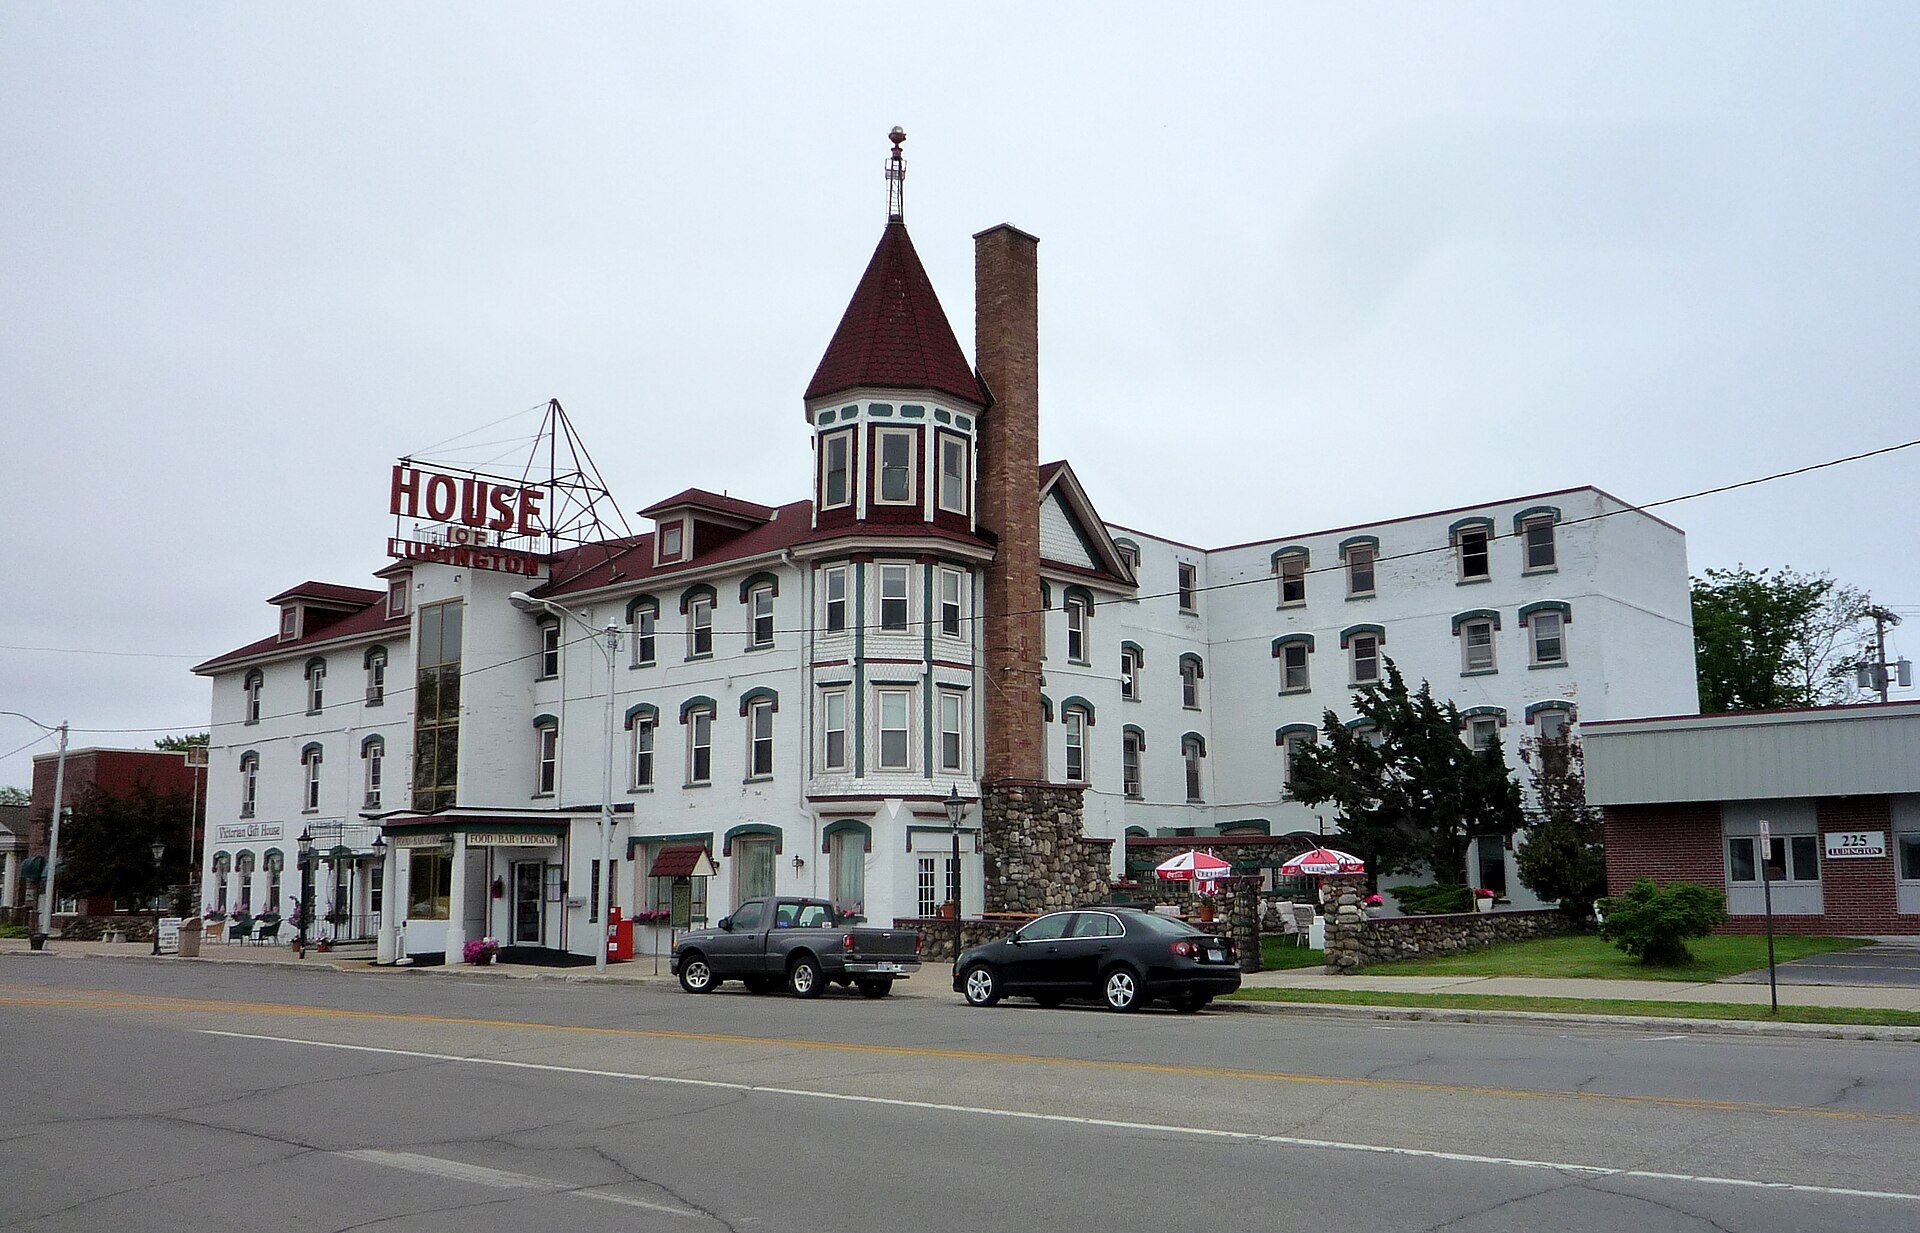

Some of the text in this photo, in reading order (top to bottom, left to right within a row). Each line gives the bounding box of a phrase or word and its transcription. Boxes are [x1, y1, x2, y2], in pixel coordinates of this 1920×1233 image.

[390, 465, 544, 536] HOUSE
[455, 528, 488, 545] OF
[387, 537, 539, 576] LUDINGTON
[219, 823, 280, 839] Victorian Gift House
[470, 834, 555, 845] FOOD BAR LODGING
[1842, 834, 1867, 847] 225
[1831, 847, 1880, 855] LUDINGTON
